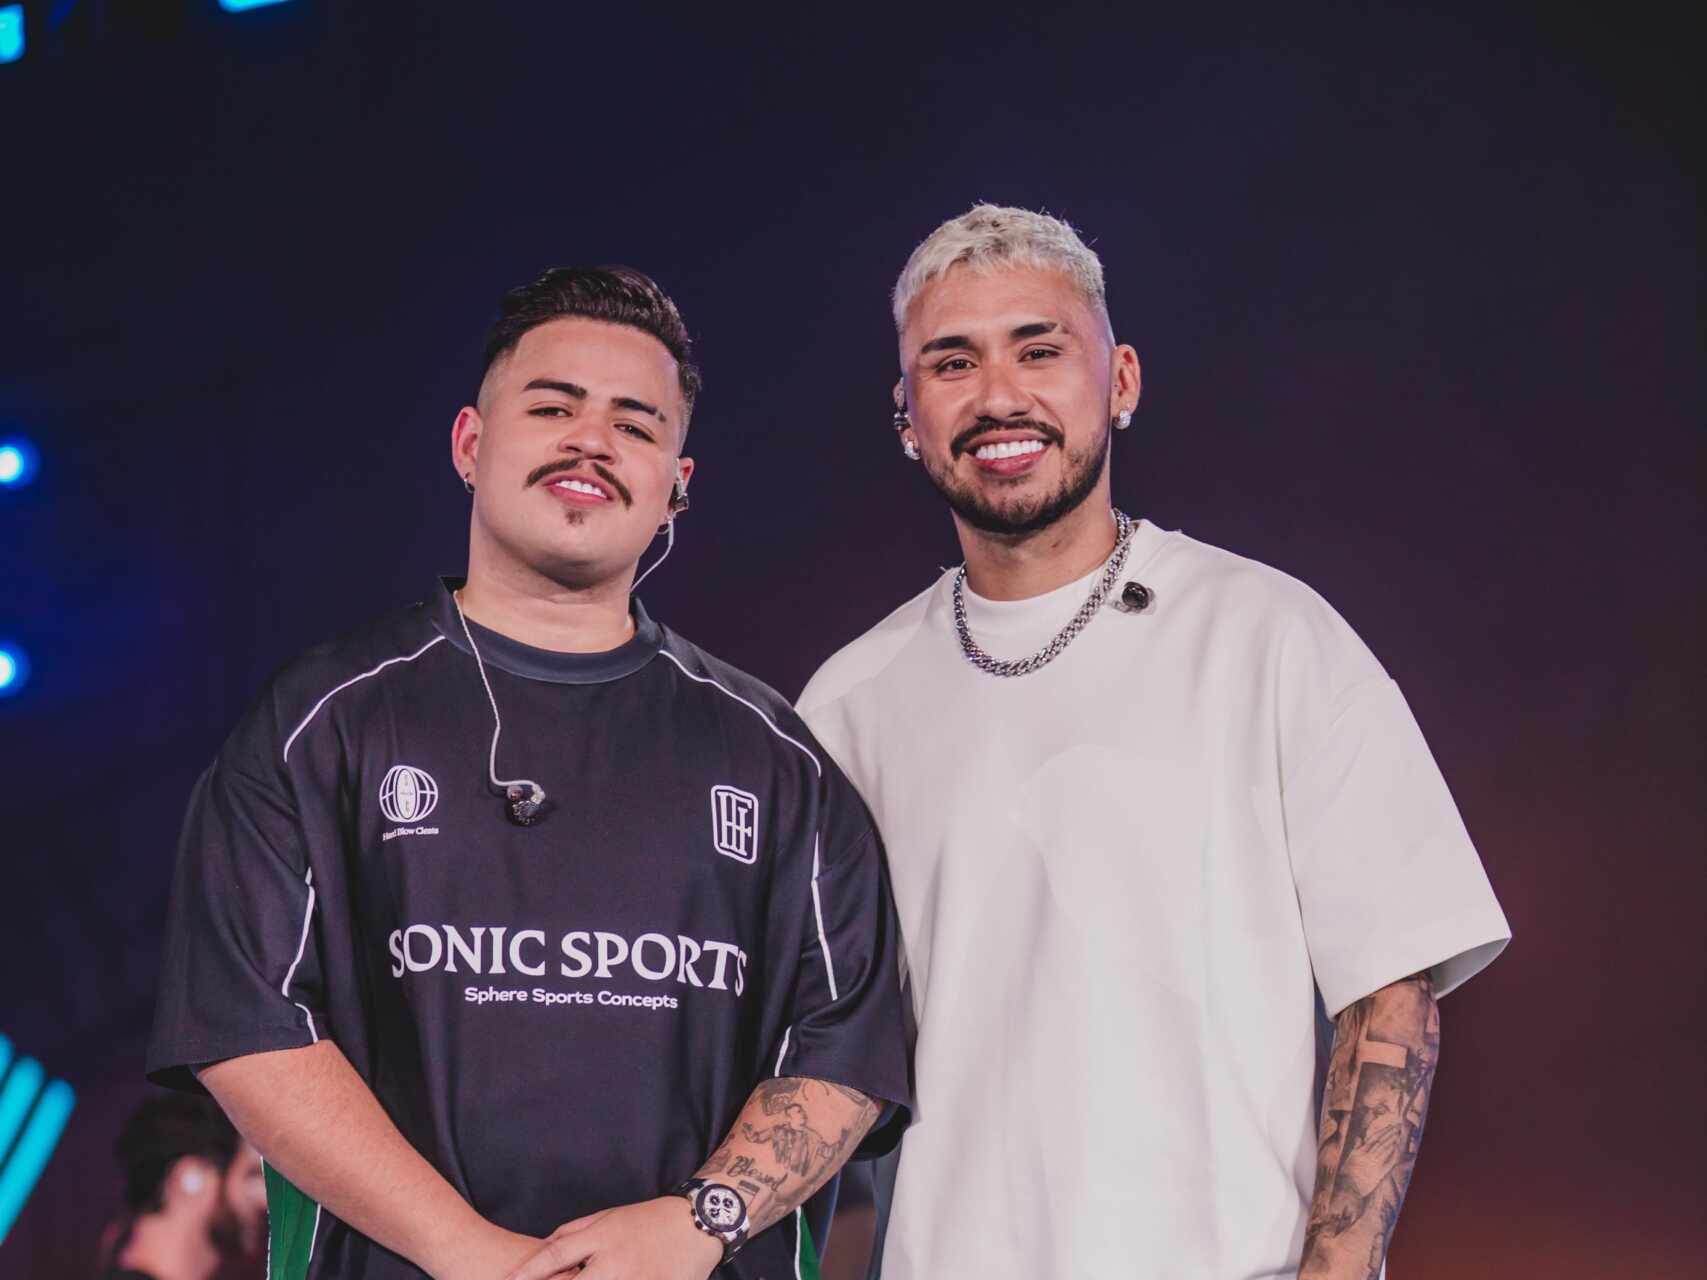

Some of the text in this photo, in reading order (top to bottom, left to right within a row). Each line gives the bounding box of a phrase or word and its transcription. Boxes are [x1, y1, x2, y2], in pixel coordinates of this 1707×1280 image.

[389, 924, 748, 997] SONIC SPORTS
[464, 986, 679, 1010] Sphere Sports Concepts
